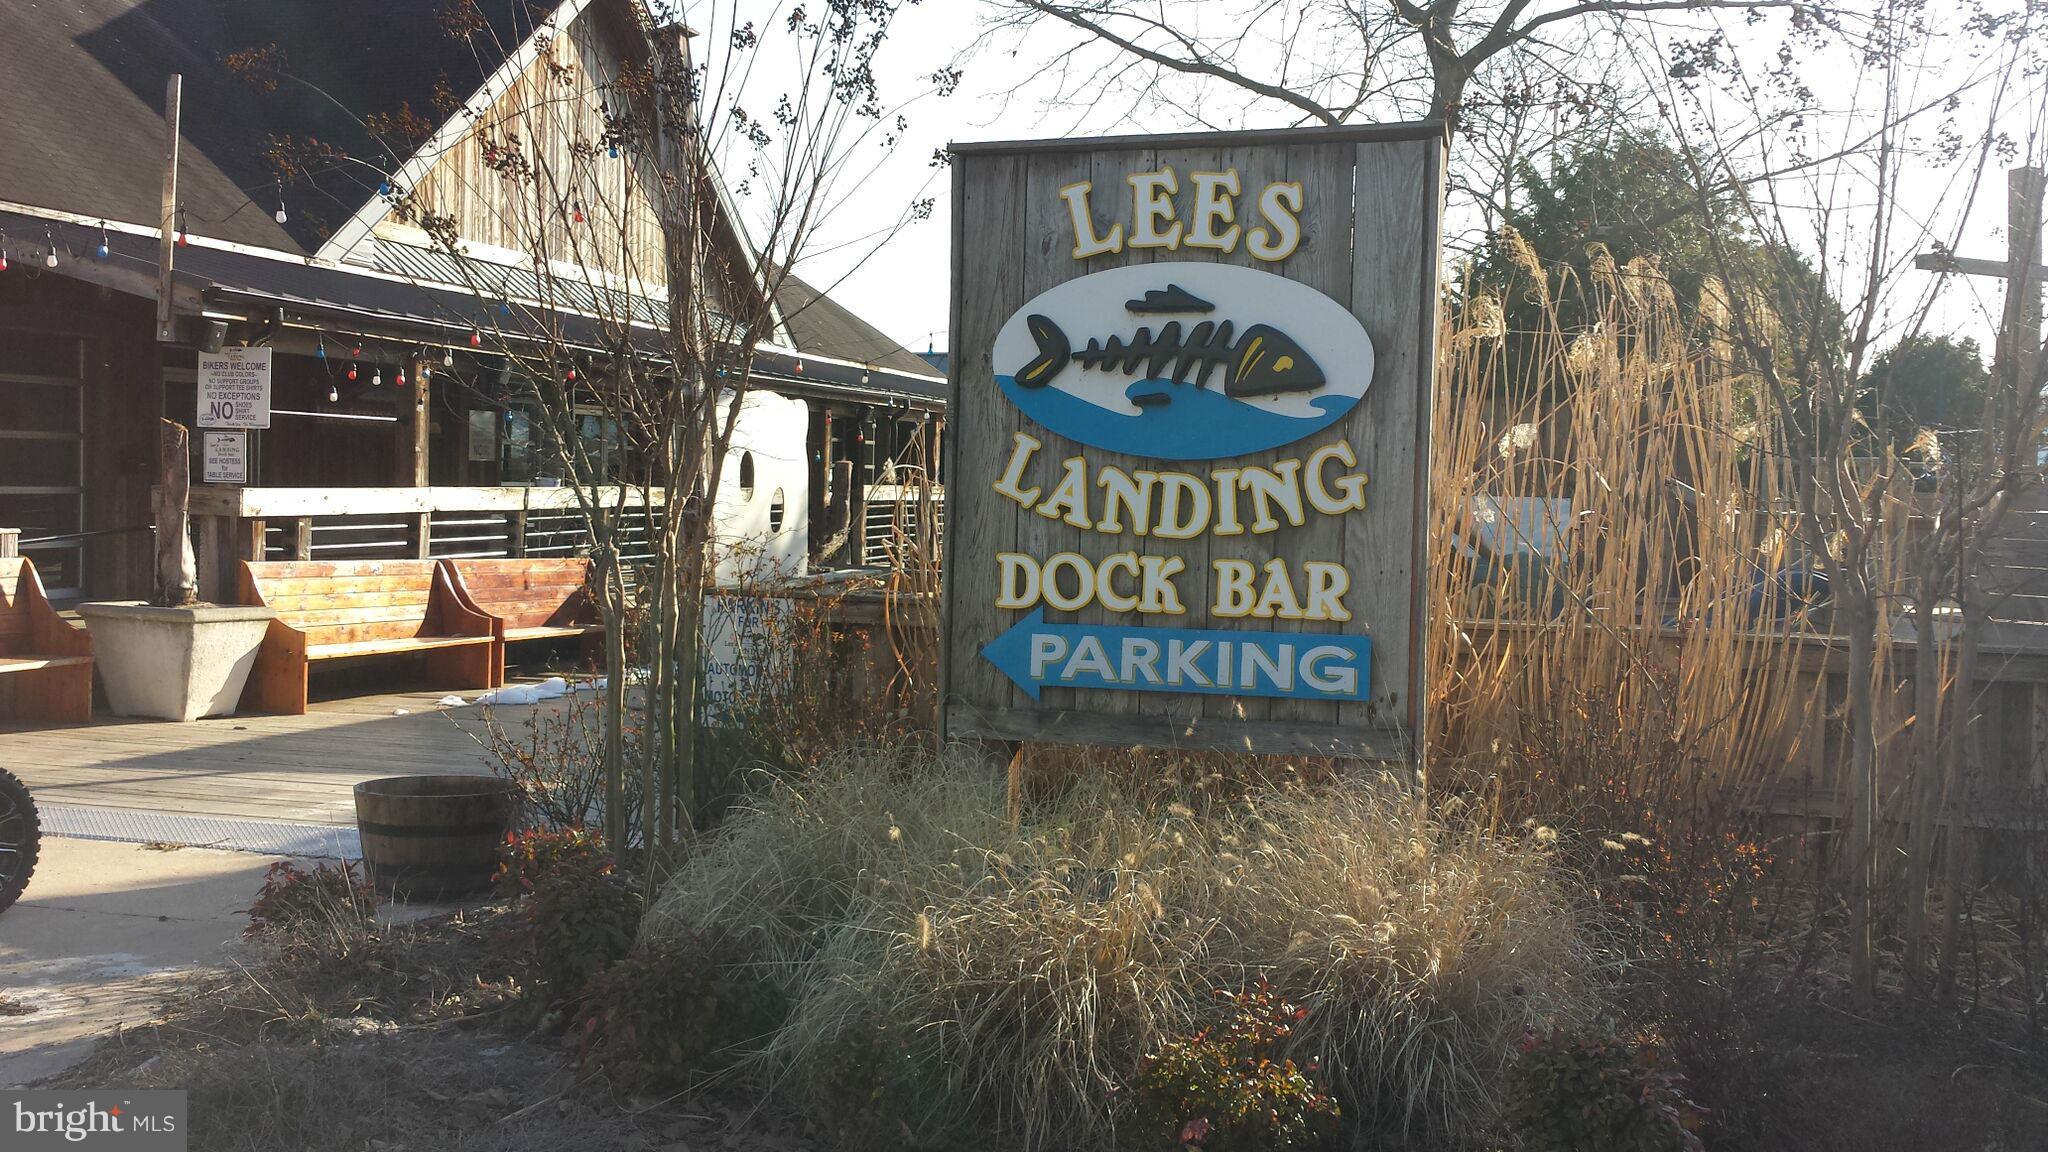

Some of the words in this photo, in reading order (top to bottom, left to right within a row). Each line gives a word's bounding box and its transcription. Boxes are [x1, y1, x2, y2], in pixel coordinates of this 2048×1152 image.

[1060, 165, 1303, 262] LEES
[203, 362, 228, 370] BIKERS
[230, 362, 266, 370] WELCOME
[219, 392, 260, 400] EXCEPTIONS
[211, 402, 233, 419] NO
[993, 432, 1368, 540] LANDING
[996, 551, 1186, 615] DOCK
[1211, 557, 1352, 621] BAR
[1029, 633, 1358, 695] PARKING
